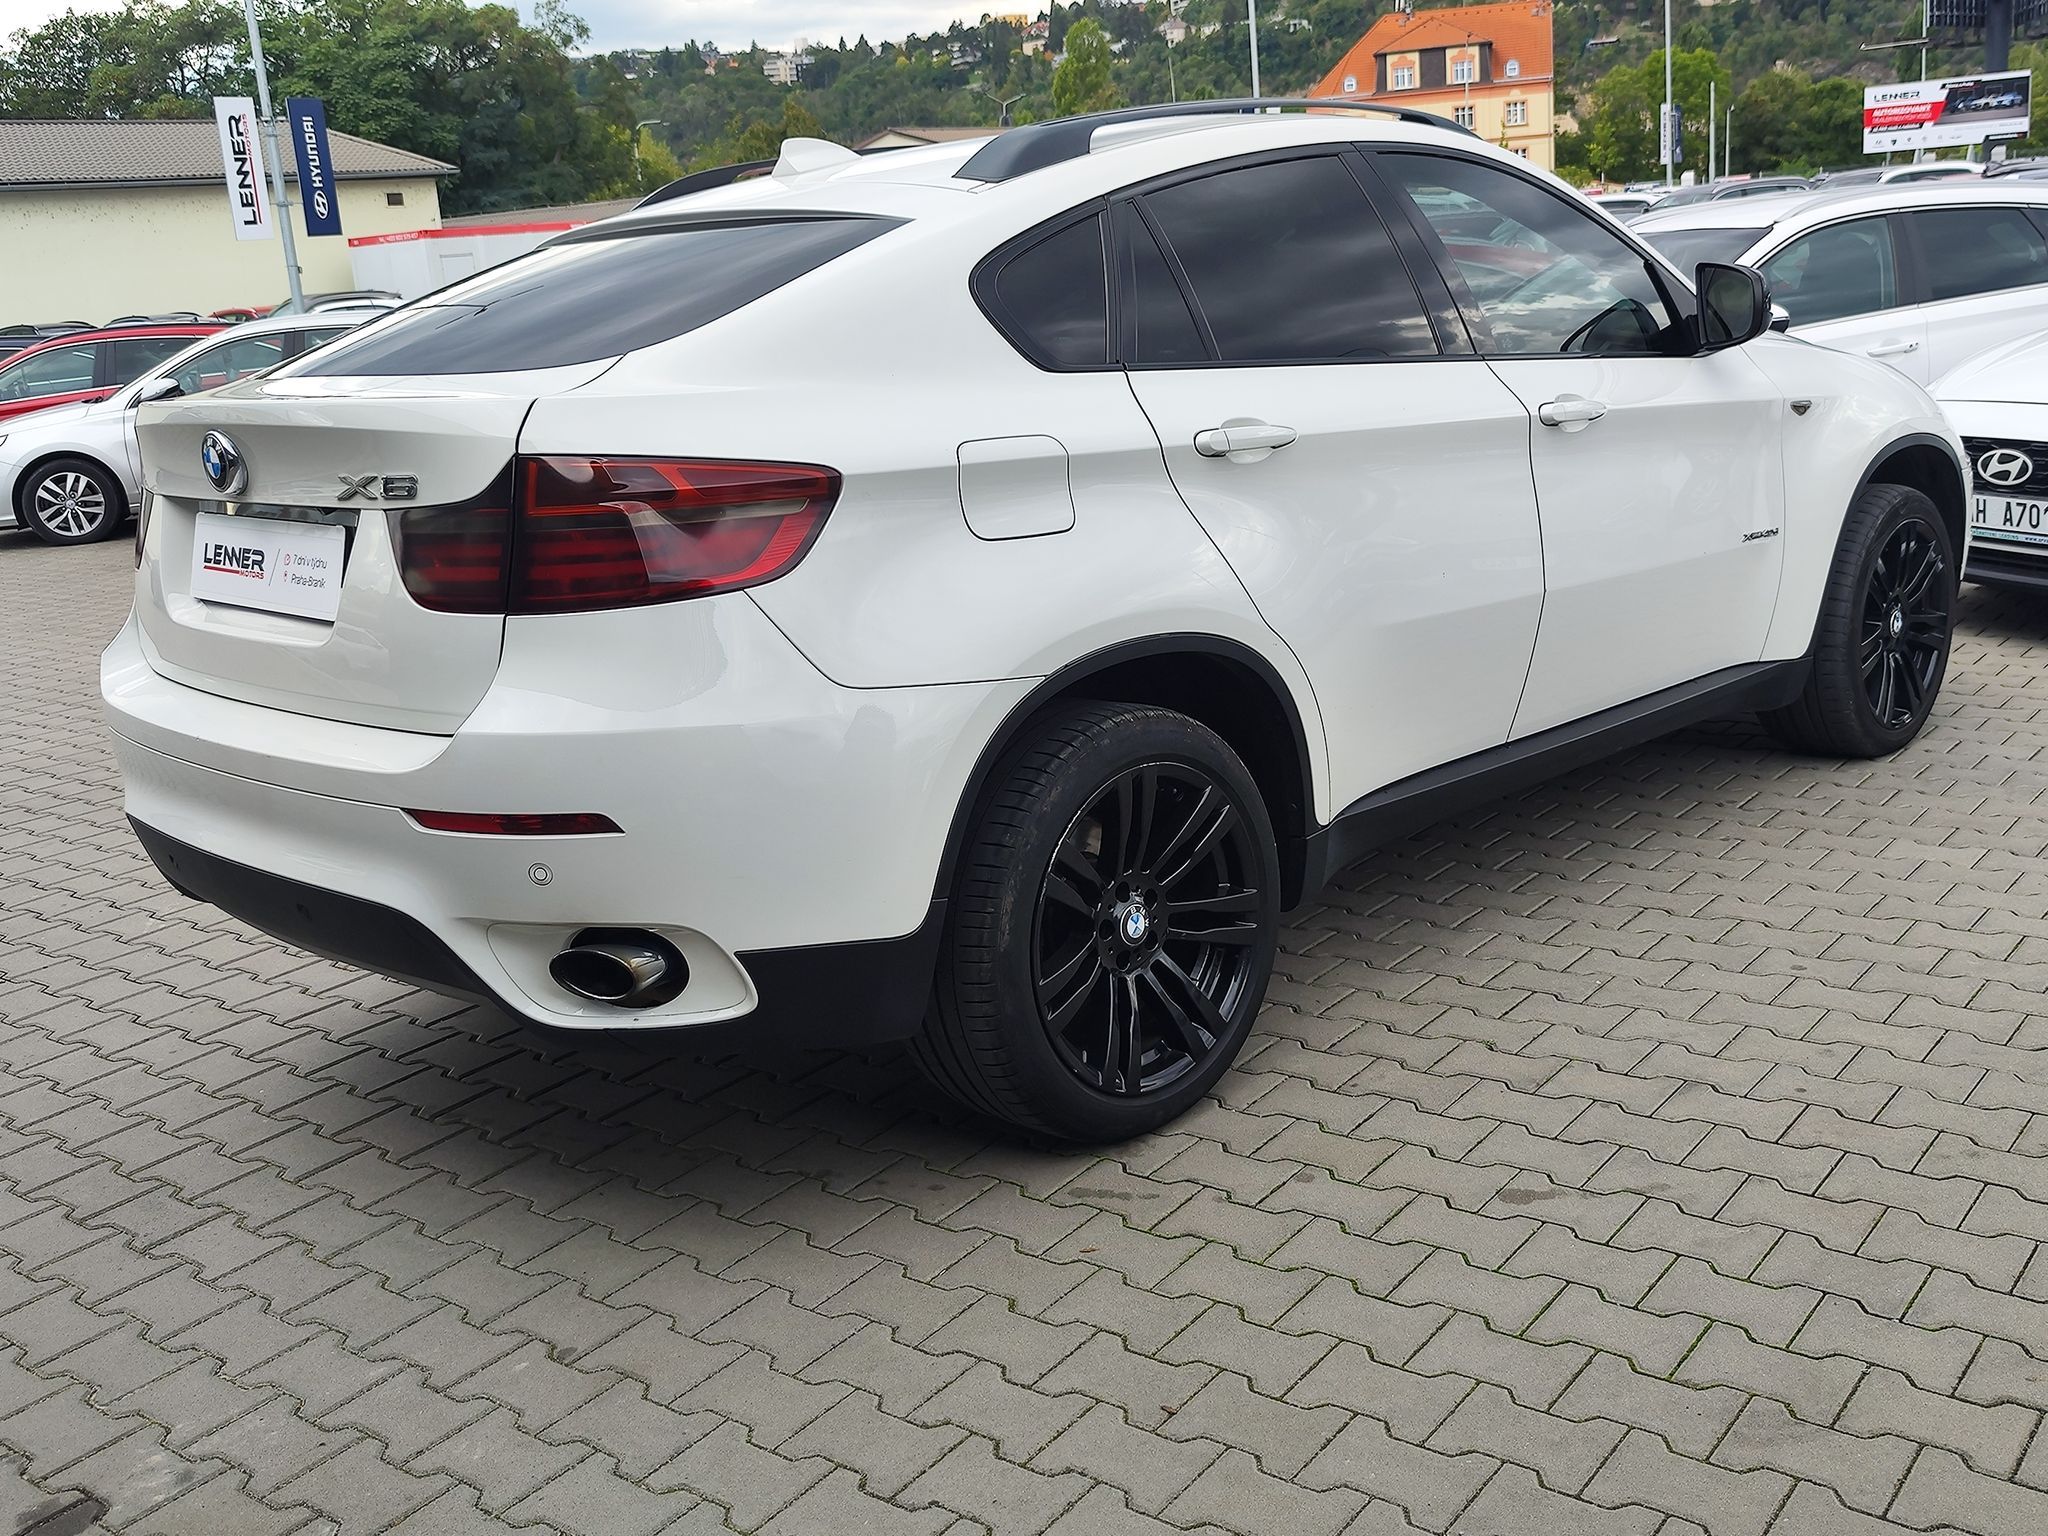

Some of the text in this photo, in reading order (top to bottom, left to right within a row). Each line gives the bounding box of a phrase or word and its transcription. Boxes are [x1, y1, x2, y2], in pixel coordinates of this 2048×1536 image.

[1873, 91, 1920, 102] LENNER
[241, 113, 252, 156] MOTORS
[302, 116, 324, 188] HYUNDAI
[228, 114, 258, 226] LENNER
[336, 474, 418, 500] X6
[203, 543, 265, 571] LENNER
[293, 554, 298, 564] 7
[239, 569, 265, 580] MOTORS
